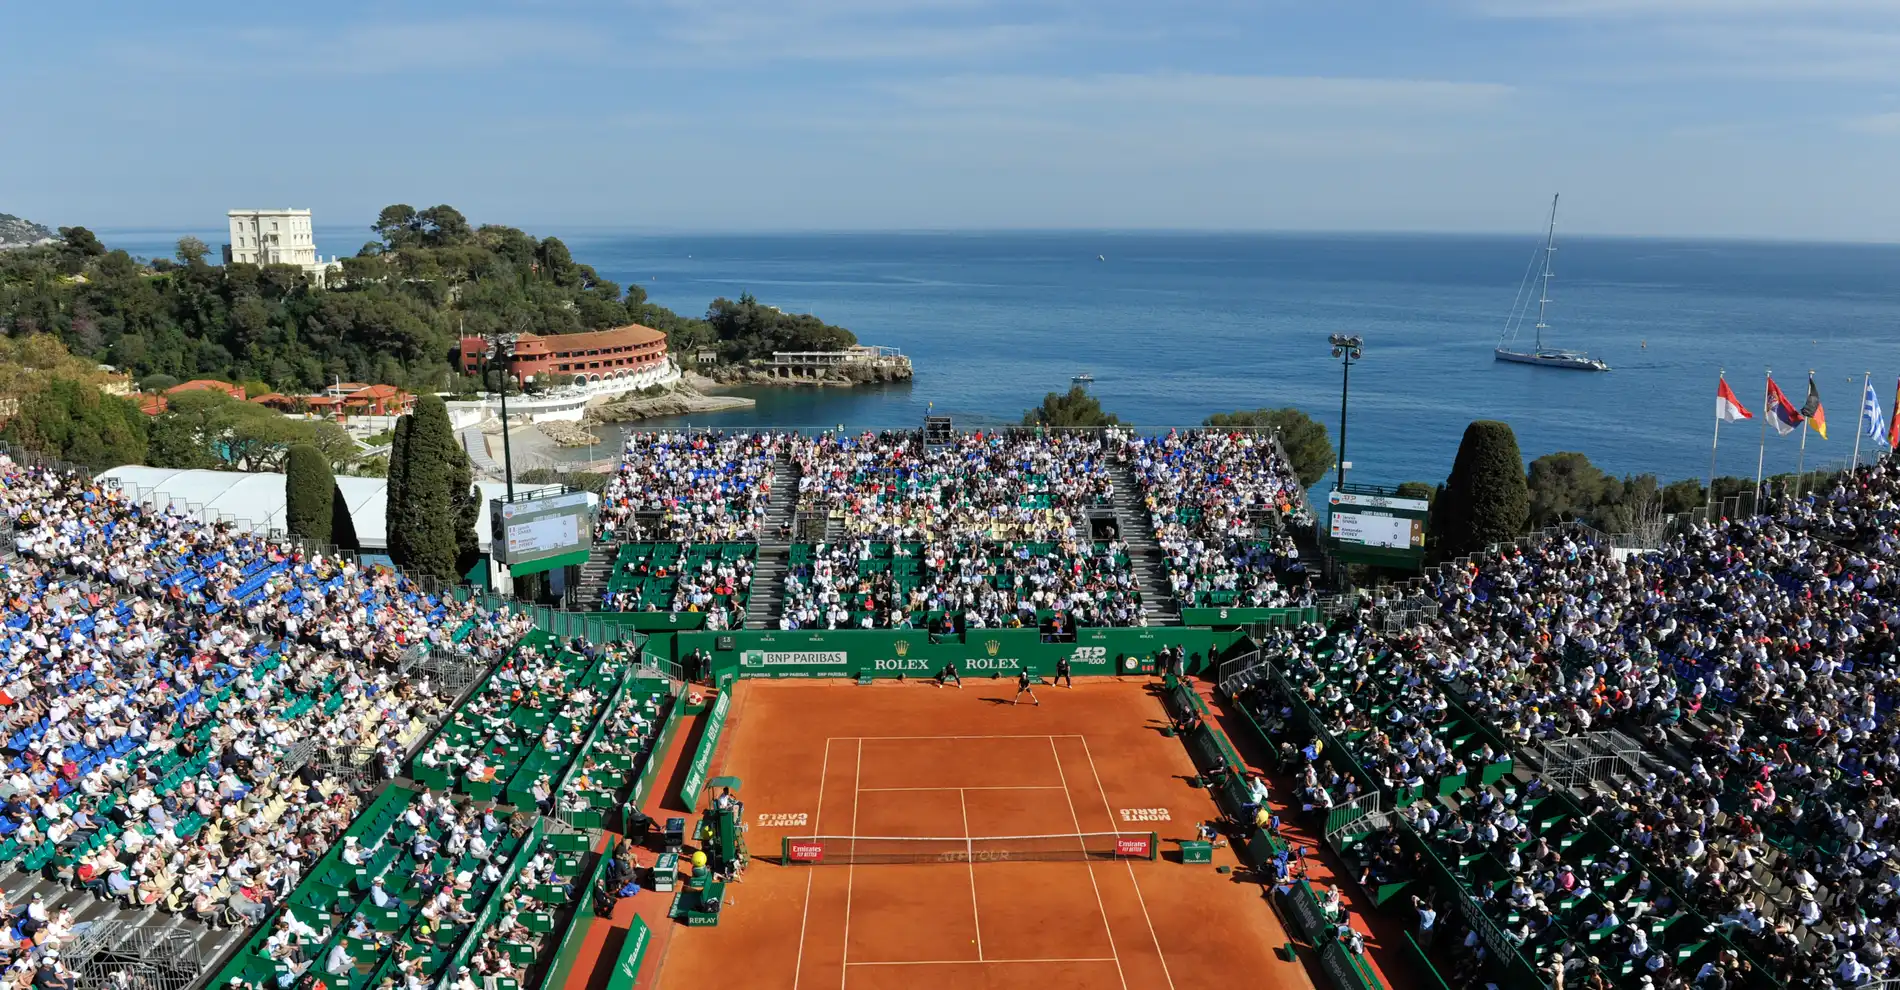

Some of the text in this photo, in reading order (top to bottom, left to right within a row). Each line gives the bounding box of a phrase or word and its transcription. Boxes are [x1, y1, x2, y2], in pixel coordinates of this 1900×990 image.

[670, 614, 677, 622] S
[767, 653, 841, 663] BNP PARIBAS
[1070, 647, 1106, 658] ATP
[875, 659, 929, 670] ROLEX
[966, 658, 1020, 669] ROLEX
[759, 813, 808, 821] CARLO
[972, 850, 1009, 861] TOUR
[628, 925, 647, 966] Maserati
